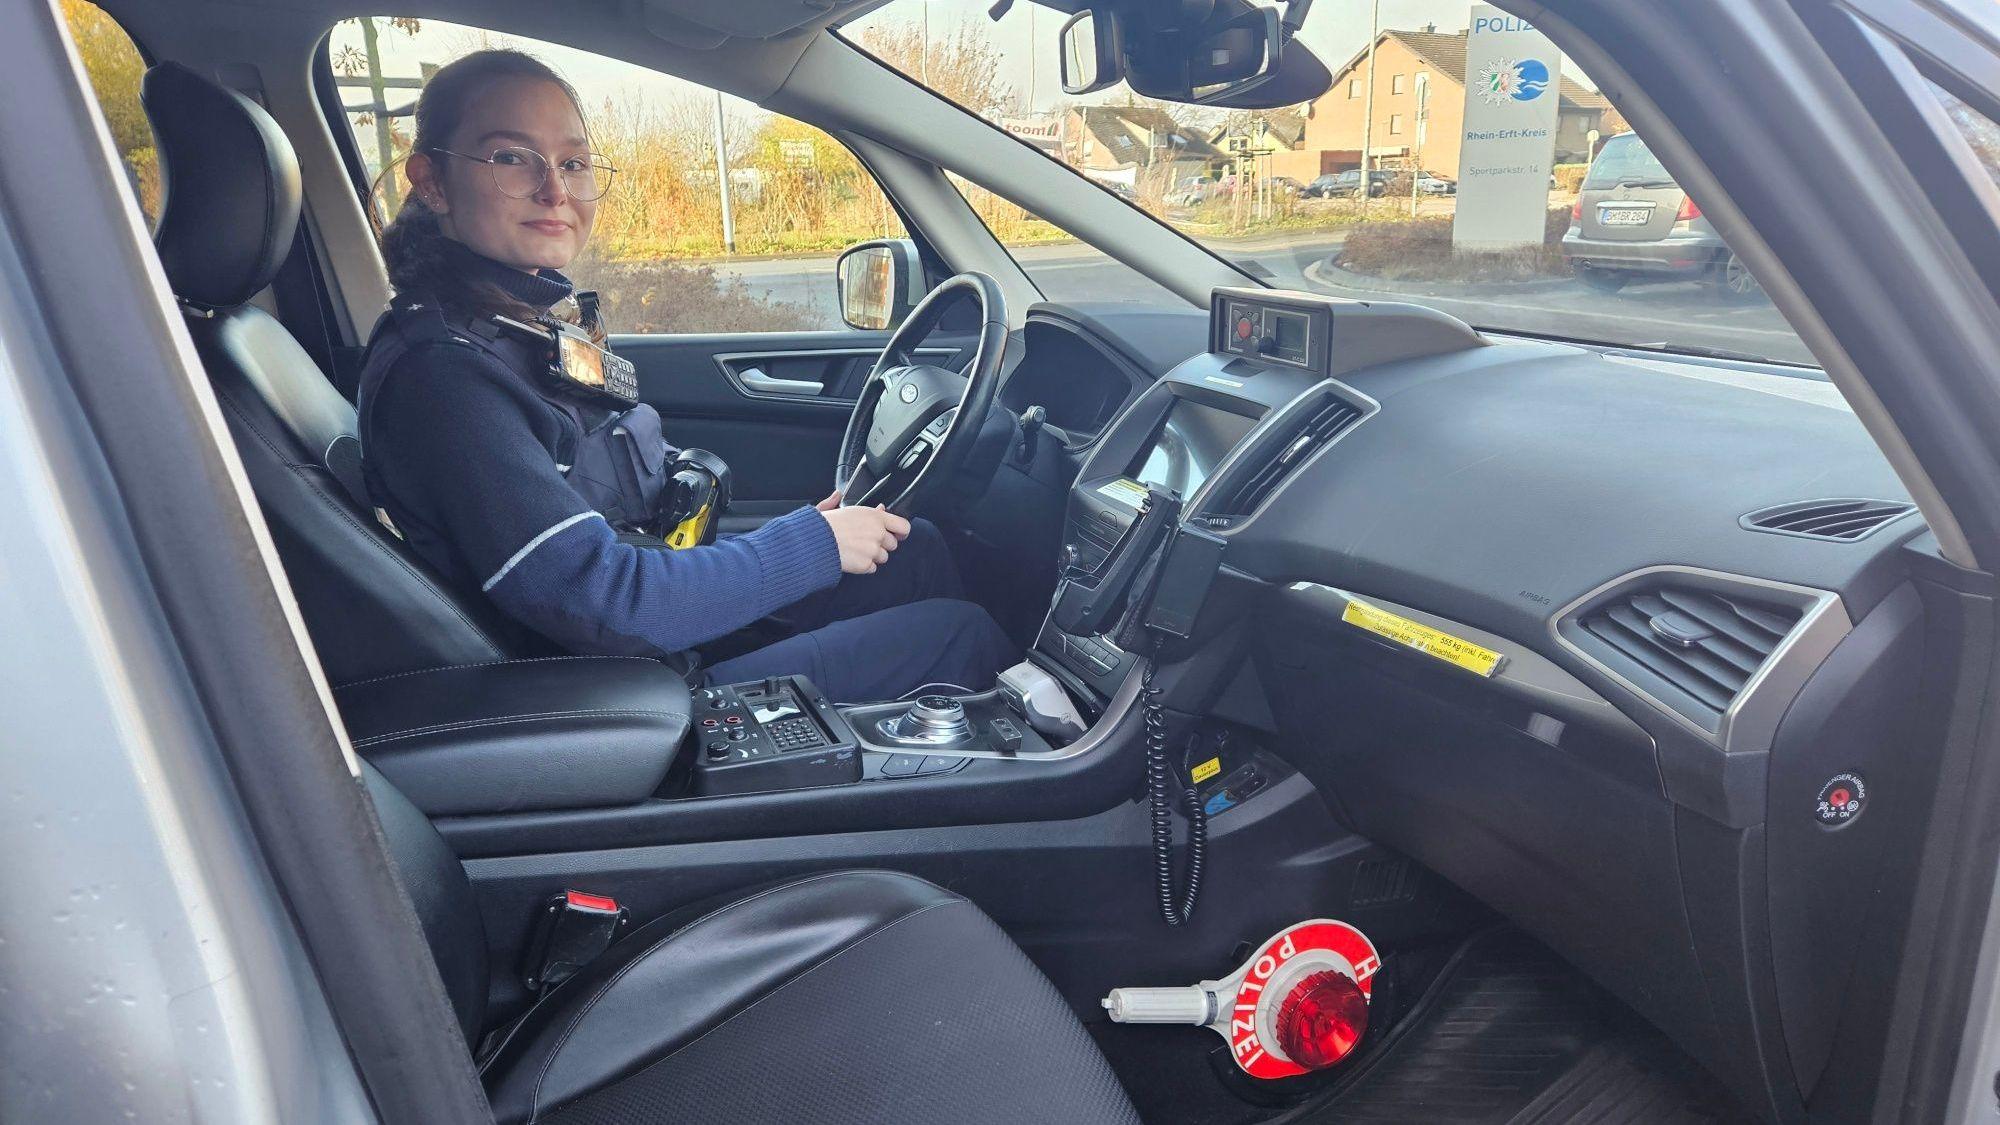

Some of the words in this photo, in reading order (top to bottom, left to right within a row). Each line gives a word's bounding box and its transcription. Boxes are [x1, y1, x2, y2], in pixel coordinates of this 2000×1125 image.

[1467, 128, 1547, 140] Rhein-Erft-Kreis
[1519, 590, 1551, 606] AIRBAG
[1453, 643, 1462, 651] kg
[1850, 776, 1865, 798] AIRBAG
[1232, 934, 1297, 1069] POLIZEI
